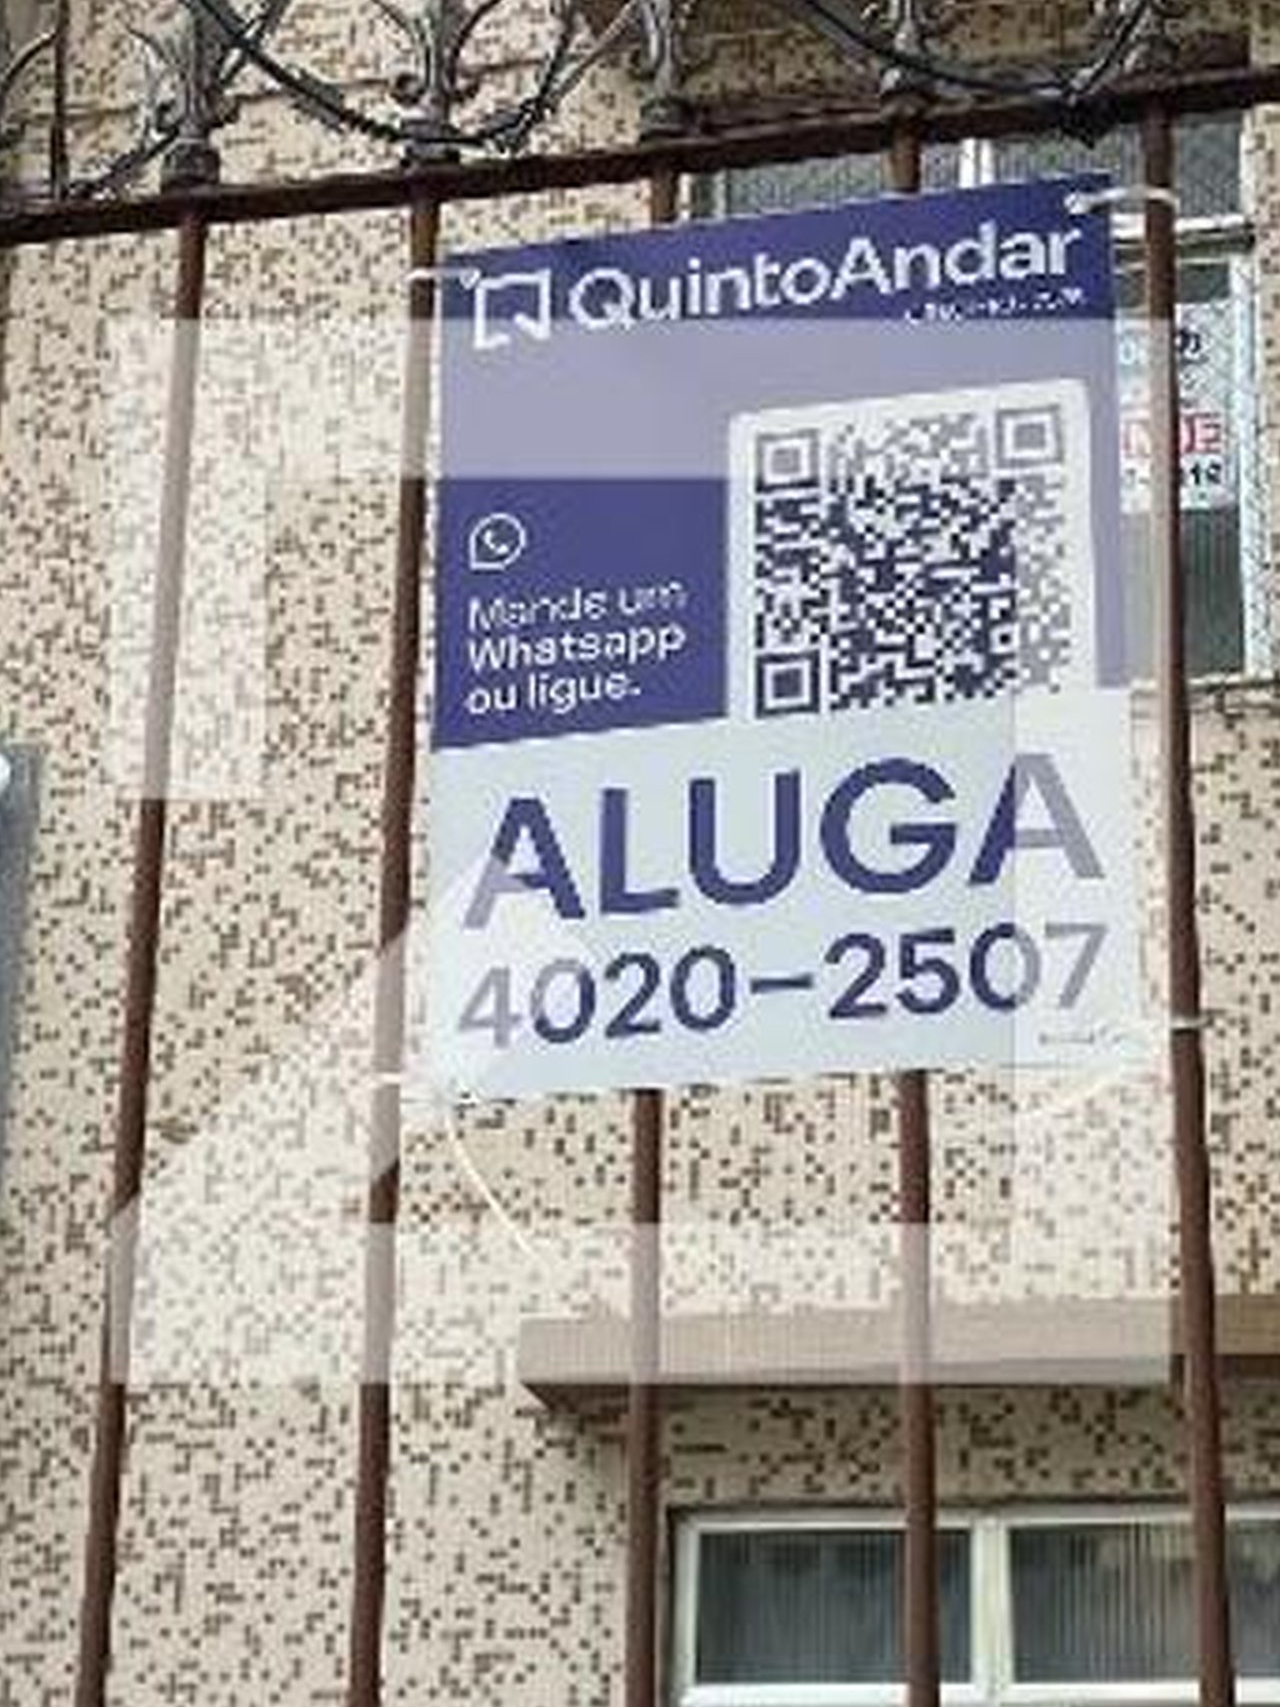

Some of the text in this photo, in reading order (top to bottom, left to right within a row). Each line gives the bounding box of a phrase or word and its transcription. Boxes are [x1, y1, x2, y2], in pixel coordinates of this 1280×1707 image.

[570, 220, 1082, 330] QuintoAndar
[469, 582, 687, 632] Mande um
[470, 623, 686, 673] Whatsapp
[467, 672, 641, 714] ou ligue.
[463, 753, 1106, 929] ALUGA
[458, 922, 1109, 1047] 4020-2507
